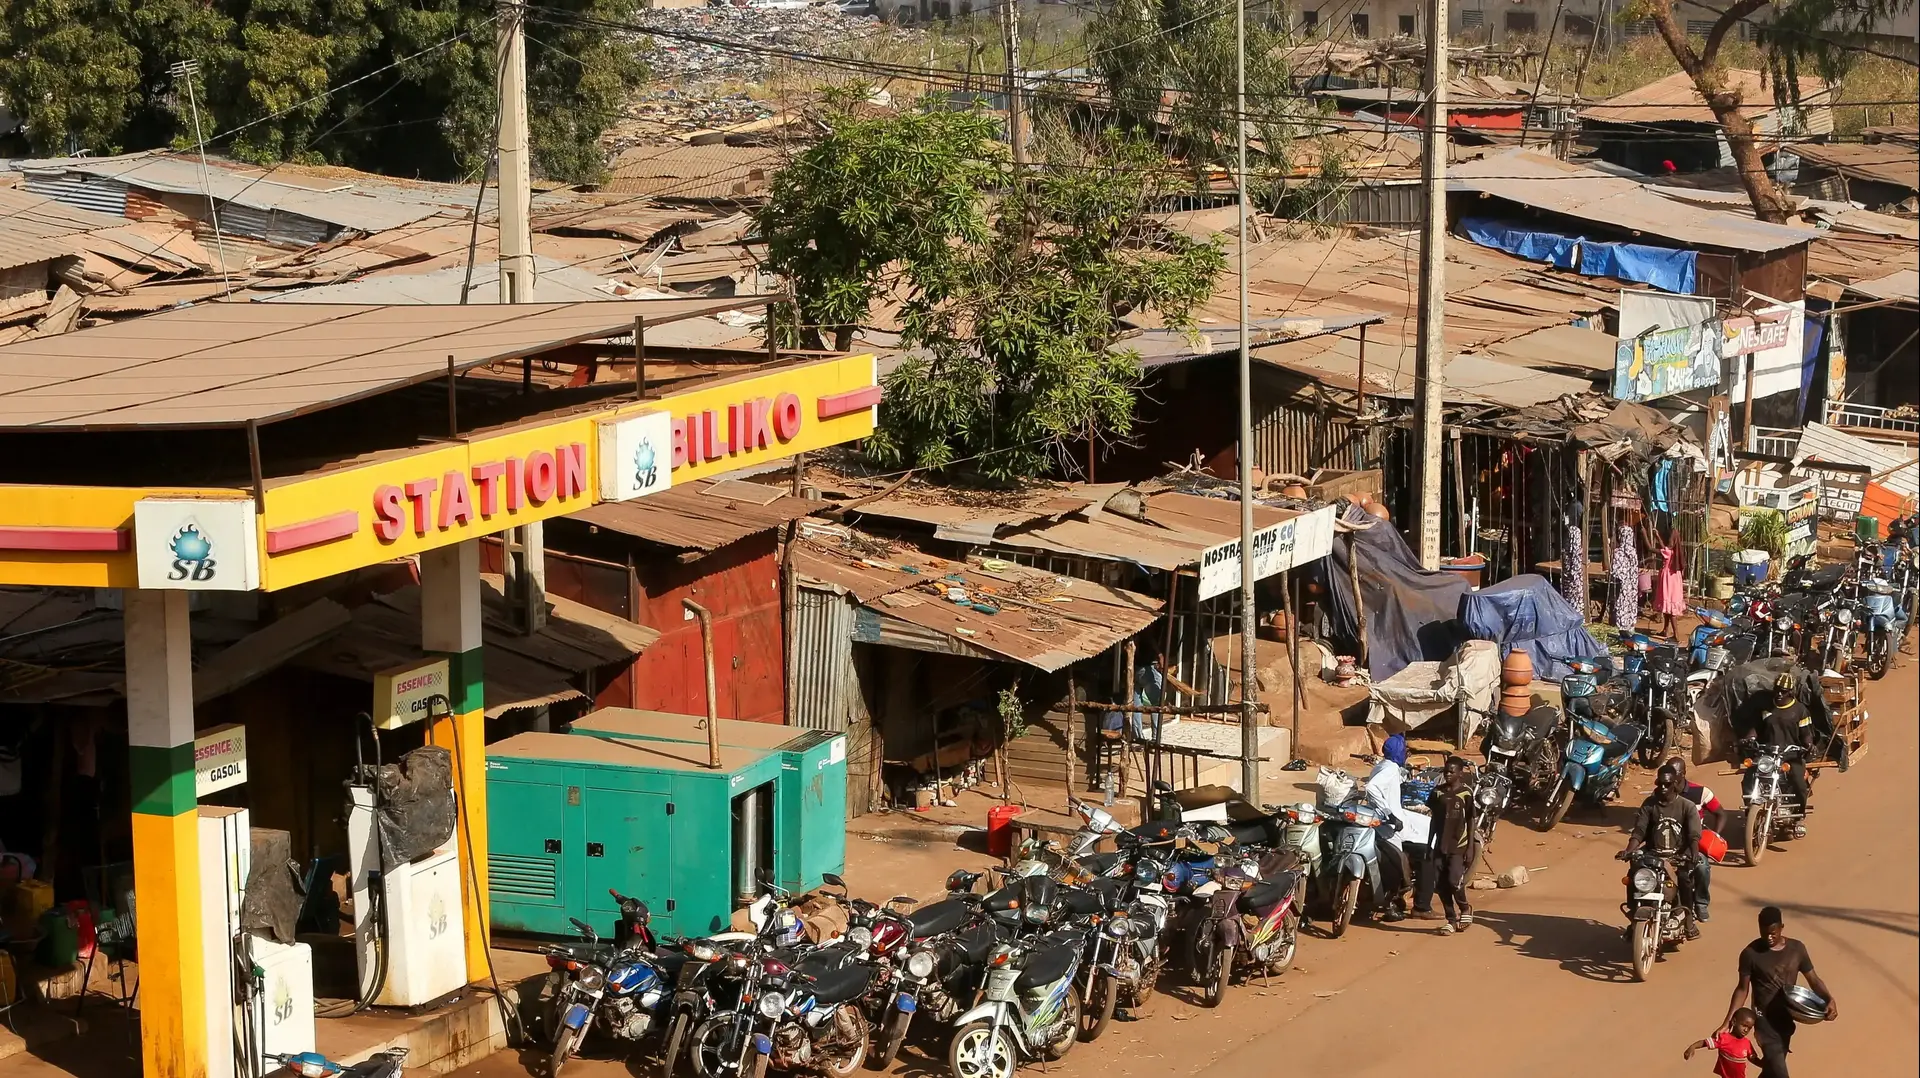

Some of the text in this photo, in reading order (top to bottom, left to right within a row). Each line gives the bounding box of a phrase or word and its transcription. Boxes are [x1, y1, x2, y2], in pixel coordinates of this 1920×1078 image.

[373, 392, 801, 540] STATION BILIKO
[633, 465, 657, 491] SB
[1789, 465, 1863, 485] HOUSE
[167, 559, 216, 581] SB
[397, 673, 433, 695] ESSENCE
[1662, 828, 1670, 849] 1
[429, 914, 449, 941] SB
[273, 997, 293, 1027] SB
